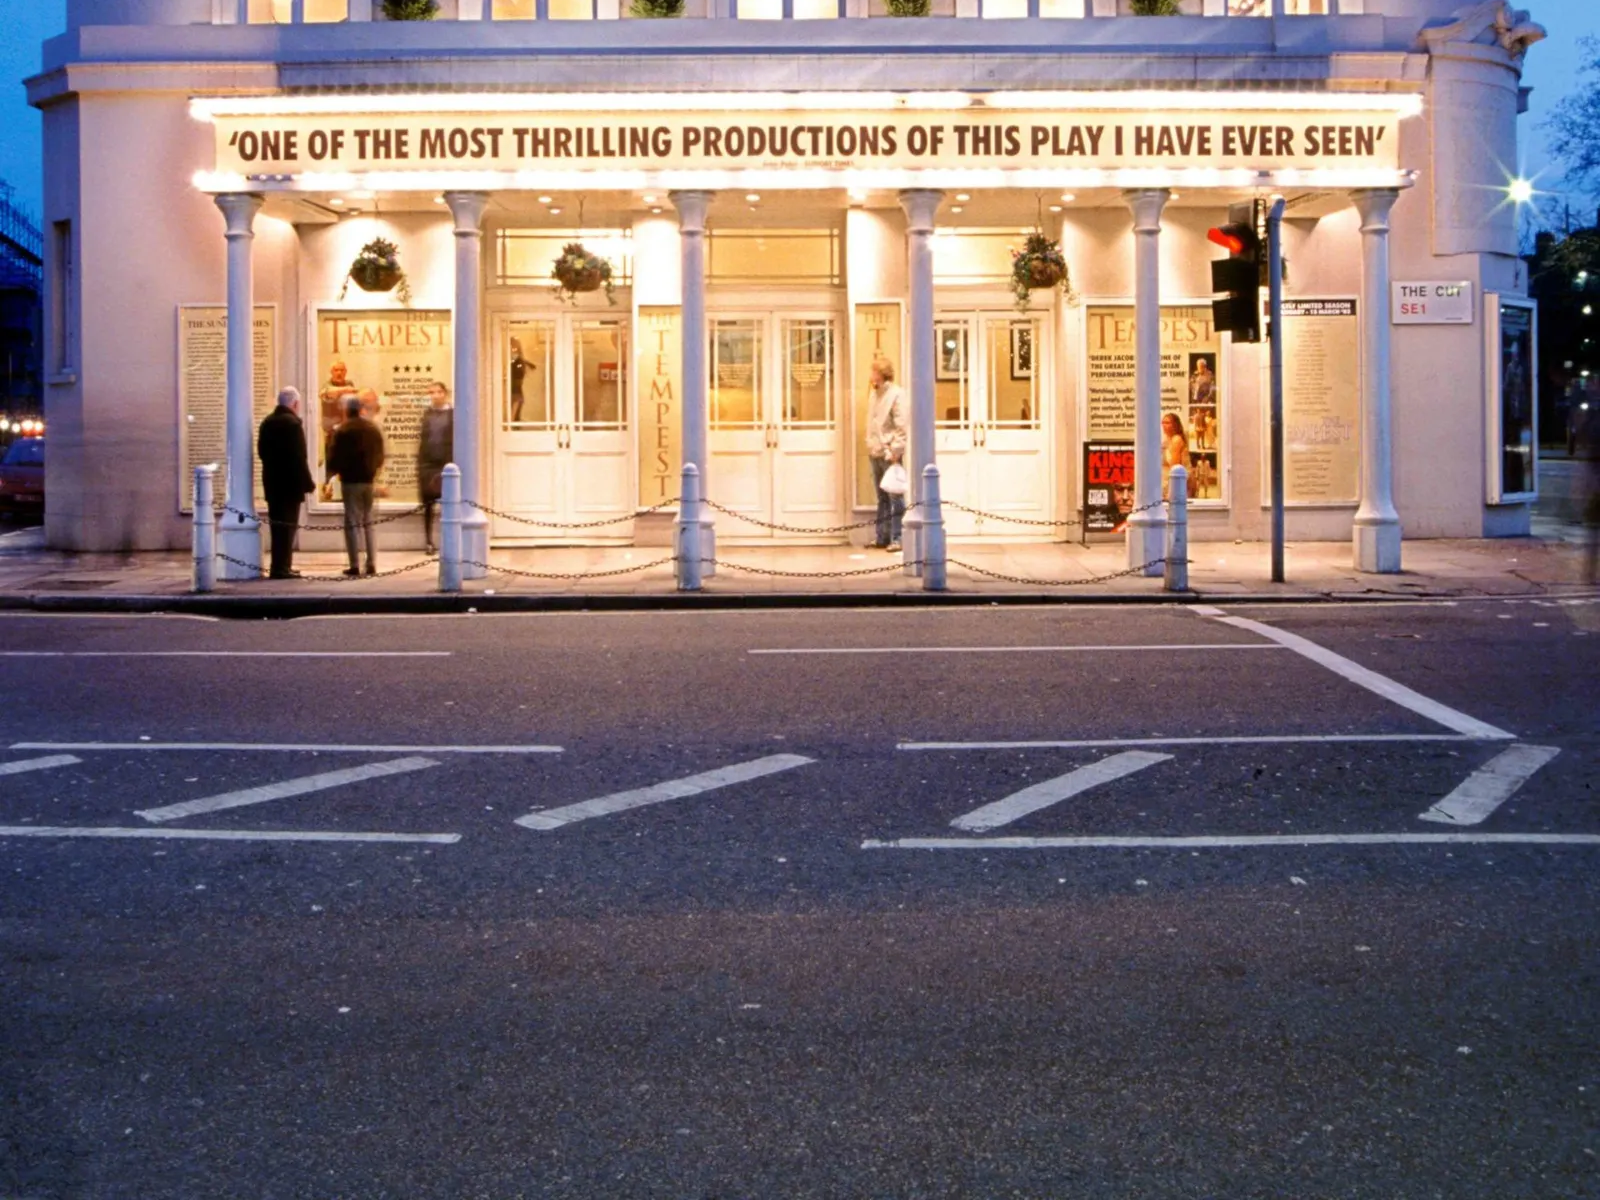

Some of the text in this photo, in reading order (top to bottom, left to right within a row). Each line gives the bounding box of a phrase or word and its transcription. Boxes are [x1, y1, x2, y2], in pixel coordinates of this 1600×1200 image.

[308, 130, 344, 160] OF
[354, 130, 408, 159] THE
[420, 128, 503, 158] MOST
[513, 127, 671, 157] THRILLING
[683, 126, 896, 156] PRODUCTIONS
[907, 126, 944, 155] OF
[954, 126, 1020, 156] THIS
[1032, 126, 1103, 155] PLAY
[1115, 126, 1123, 155] I
[1135, 126, 1211, 155] HAVE
[1223, 126, 1294, 156] EVER
[1401, 286, 1461, 297] THE CUT
[1172, 308, 1197, 318] THE
[1401, 303, 1426, 314] SE1
[324, 317, 450, 353] TEMPEST
[650, 329, 673, 497] TEMPEST
[1089, 453, 1135, 468] KING
[1089, 468, 1135, 484] LEAR
